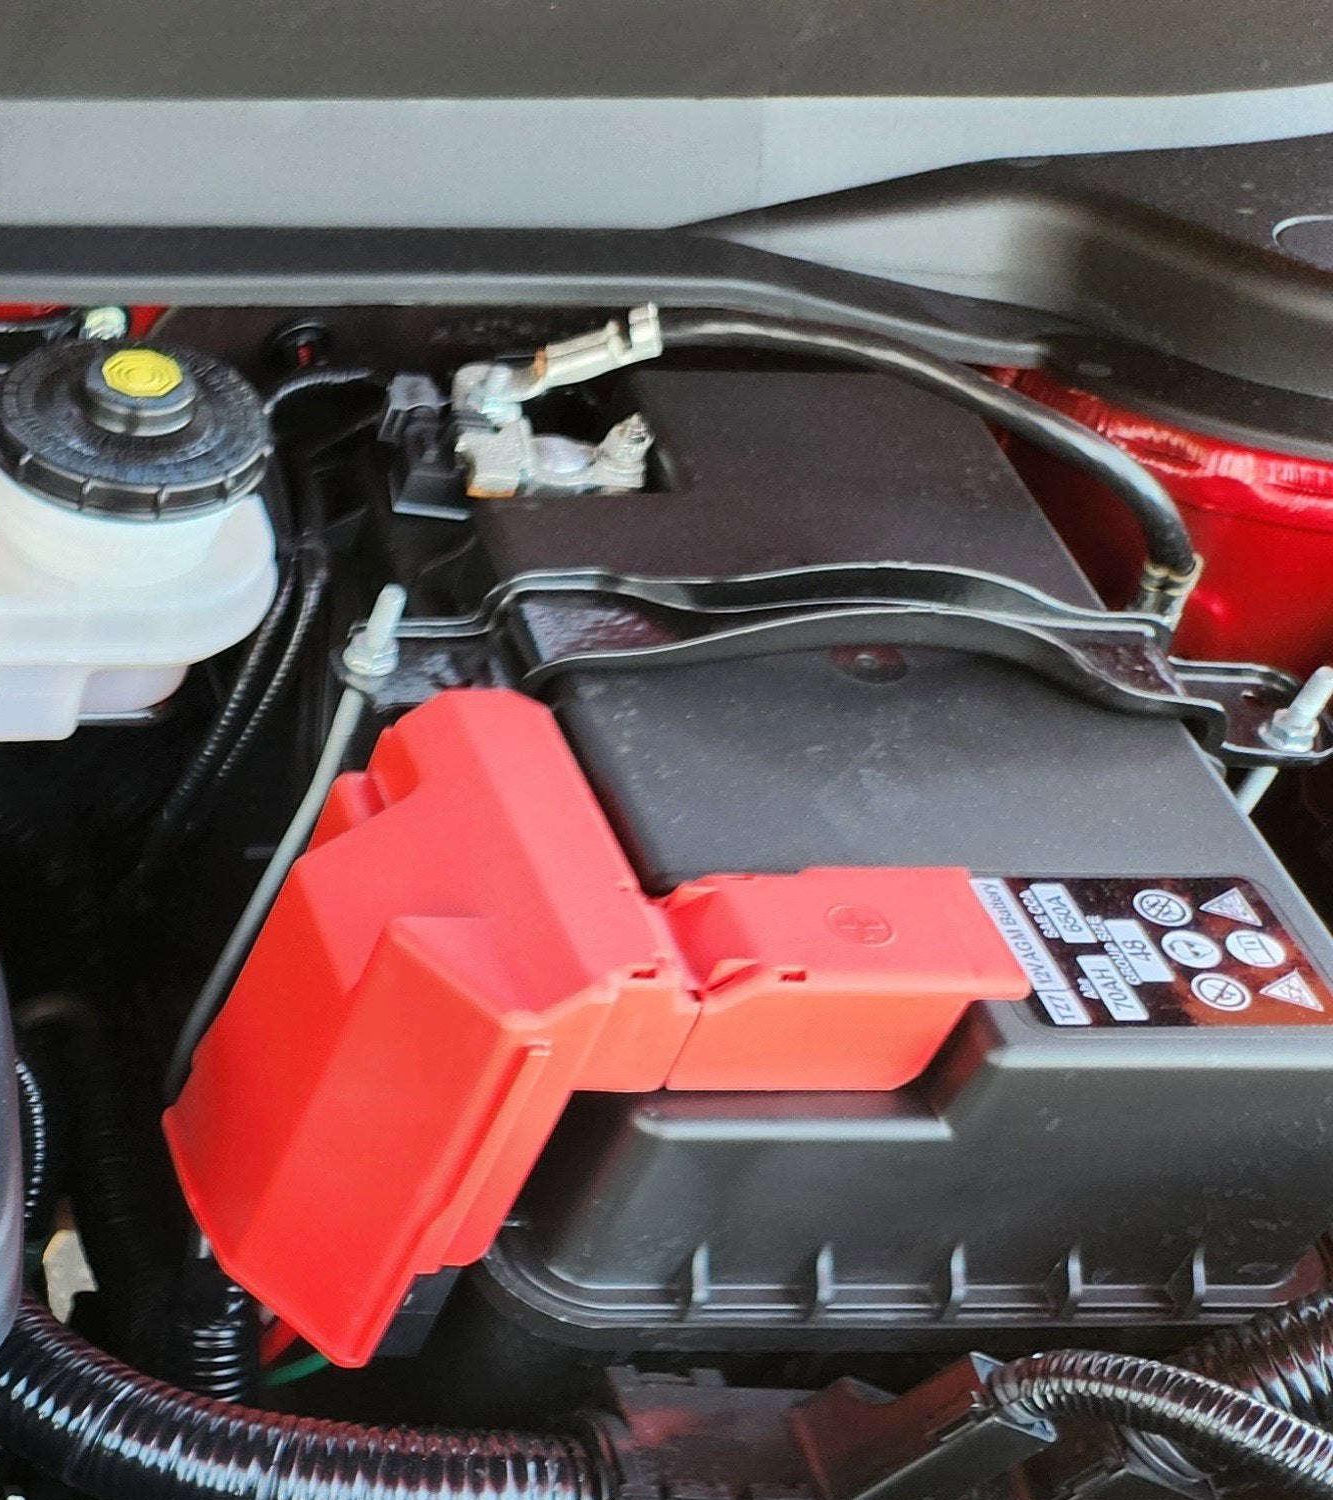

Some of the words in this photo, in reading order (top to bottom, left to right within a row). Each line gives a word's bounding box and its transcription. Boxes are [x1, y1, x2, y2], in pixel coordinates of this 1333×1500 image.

[979, 882, 1014, 926] Battery
[1052, 894, 1083, 933] 650A
[1121, 939, 1152, 963] 48
[1046, 995, 1077, 1022] TZ7
[1092, 967, 1127, 1012] 70AH
